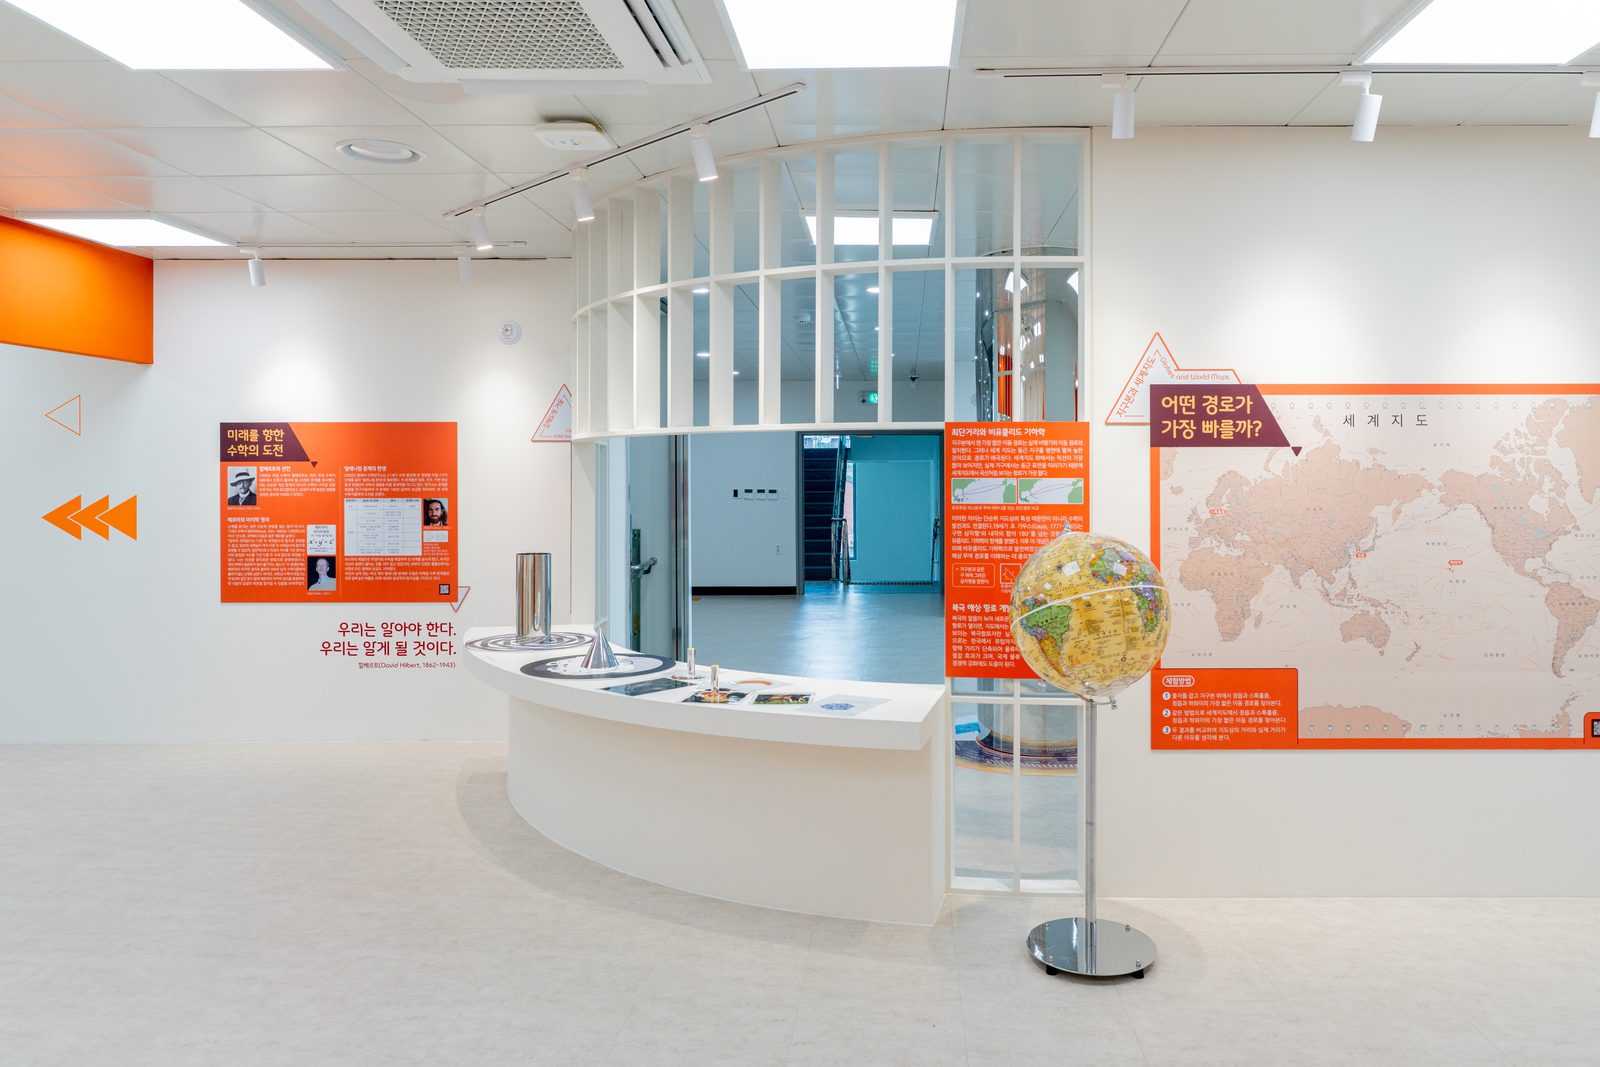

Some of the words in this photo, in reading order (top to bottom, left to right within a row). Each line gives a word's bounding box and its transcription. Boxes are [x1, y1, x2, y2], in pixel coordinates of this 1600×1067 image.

[1116, 387, 1138, 417] 지구본과
[1134, 356, 1156, 386] 세계지도
[1161, 395, 1196, 415] 어떤
[1202, 395, 1253, 415] 경로가
[227, 429, 259, 442] 미래를
[262, 429, 285, 442] 향한
[952, 428, 987, 437] 최단거리와
[988, 428, 1022, 437] 비유클리드
[1024, 428, 1046, 437] 기하학
[1161, 420, 1196, 440] 가장
[1202, 420, 1262, 440] 빠를까?
[227, 444, 259, 457] 수학의
[262, 444, 283, 457] 도전
[952, 604, 965, 612] 북극
[967, 604, 981, 612] 해상
[983, 604, 997, 612] 항로
[338, 622, 376, 637] 우리는
[381, 622, 422, 637] 알아야
[426, 622, 456, 637] 한다.
[320, 641, 359, 656] 우리는
[363, 641, 390, 656] 알게
[395, 641, 407, 656] 될
[413, 641, 456, 656] 것이다.
[1165, 677, 1191, 685] 체험방법
